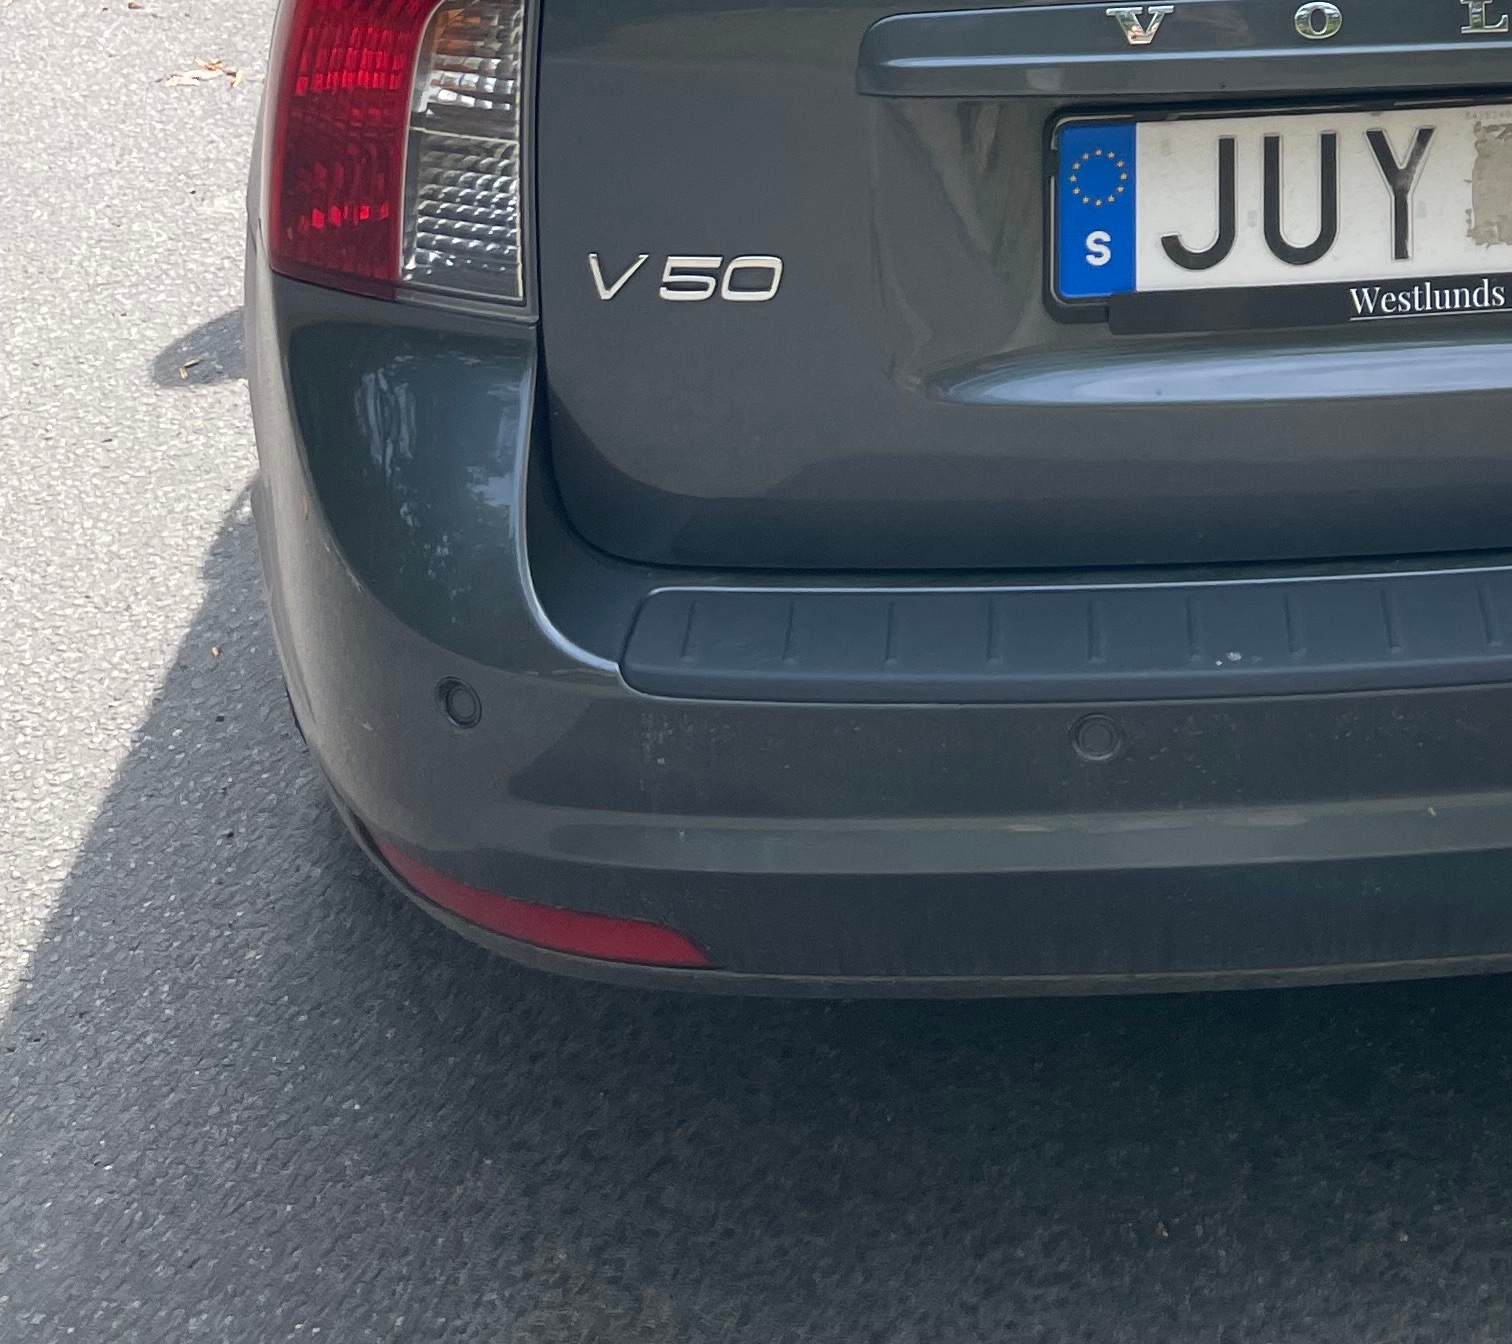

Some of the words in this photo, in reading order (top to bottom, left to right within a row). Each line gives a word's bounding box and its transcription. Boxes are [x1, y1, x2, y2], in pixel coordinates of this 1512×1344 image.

[1161, 127, 1435, 271] JUY
[1085, 231, 1112, 266] S
[1350, 278, 1505, 315] Westlunds
